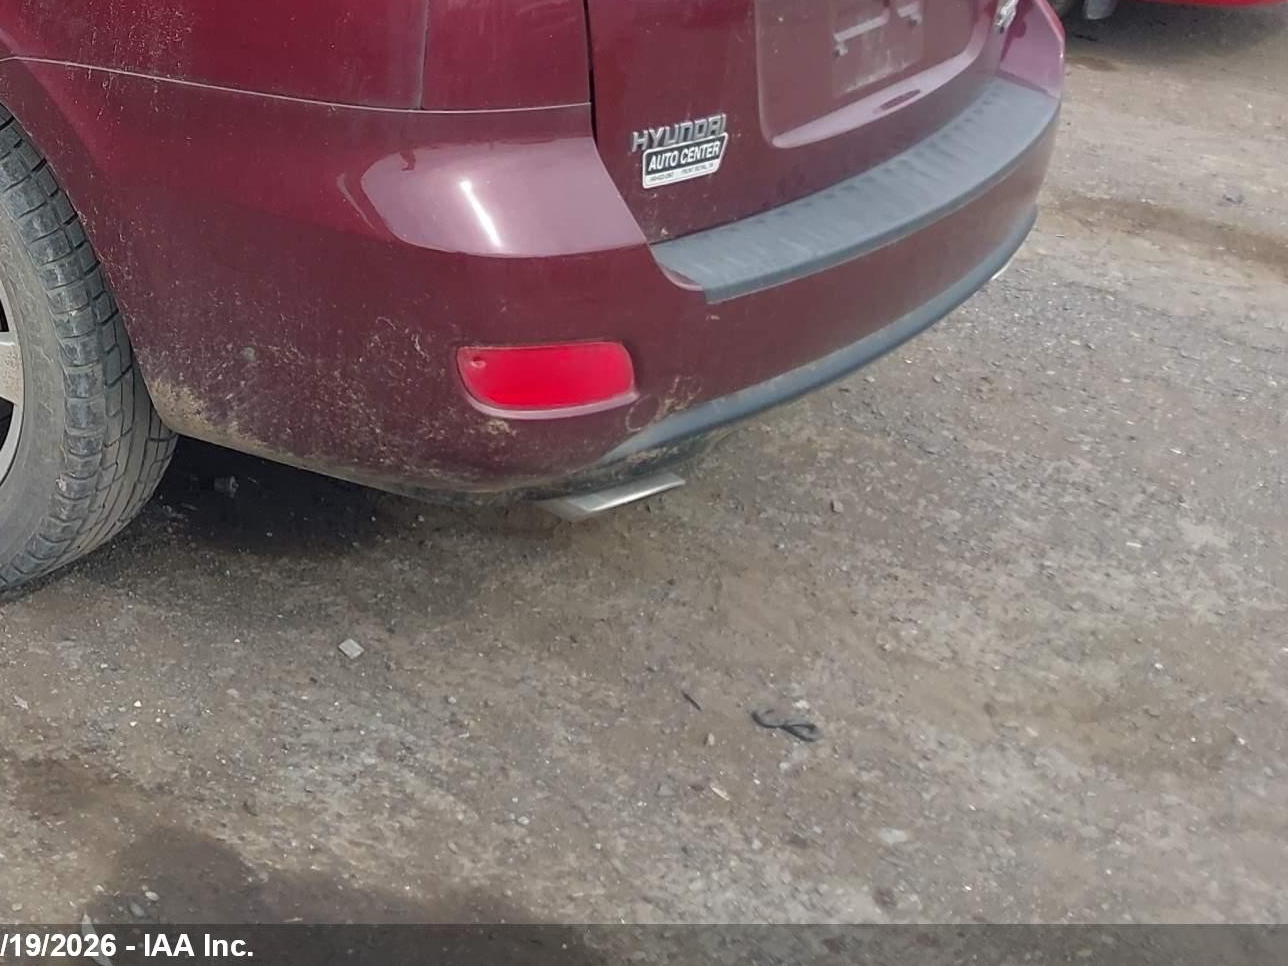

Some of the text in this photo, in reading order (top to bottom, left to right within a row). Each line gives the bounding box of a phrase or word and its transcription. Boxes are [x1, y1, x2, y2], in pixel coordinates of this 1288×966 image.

[632, 114, 727, 152] HYUNDAI
[648, 141, 721, 172] AUTO CENTER
